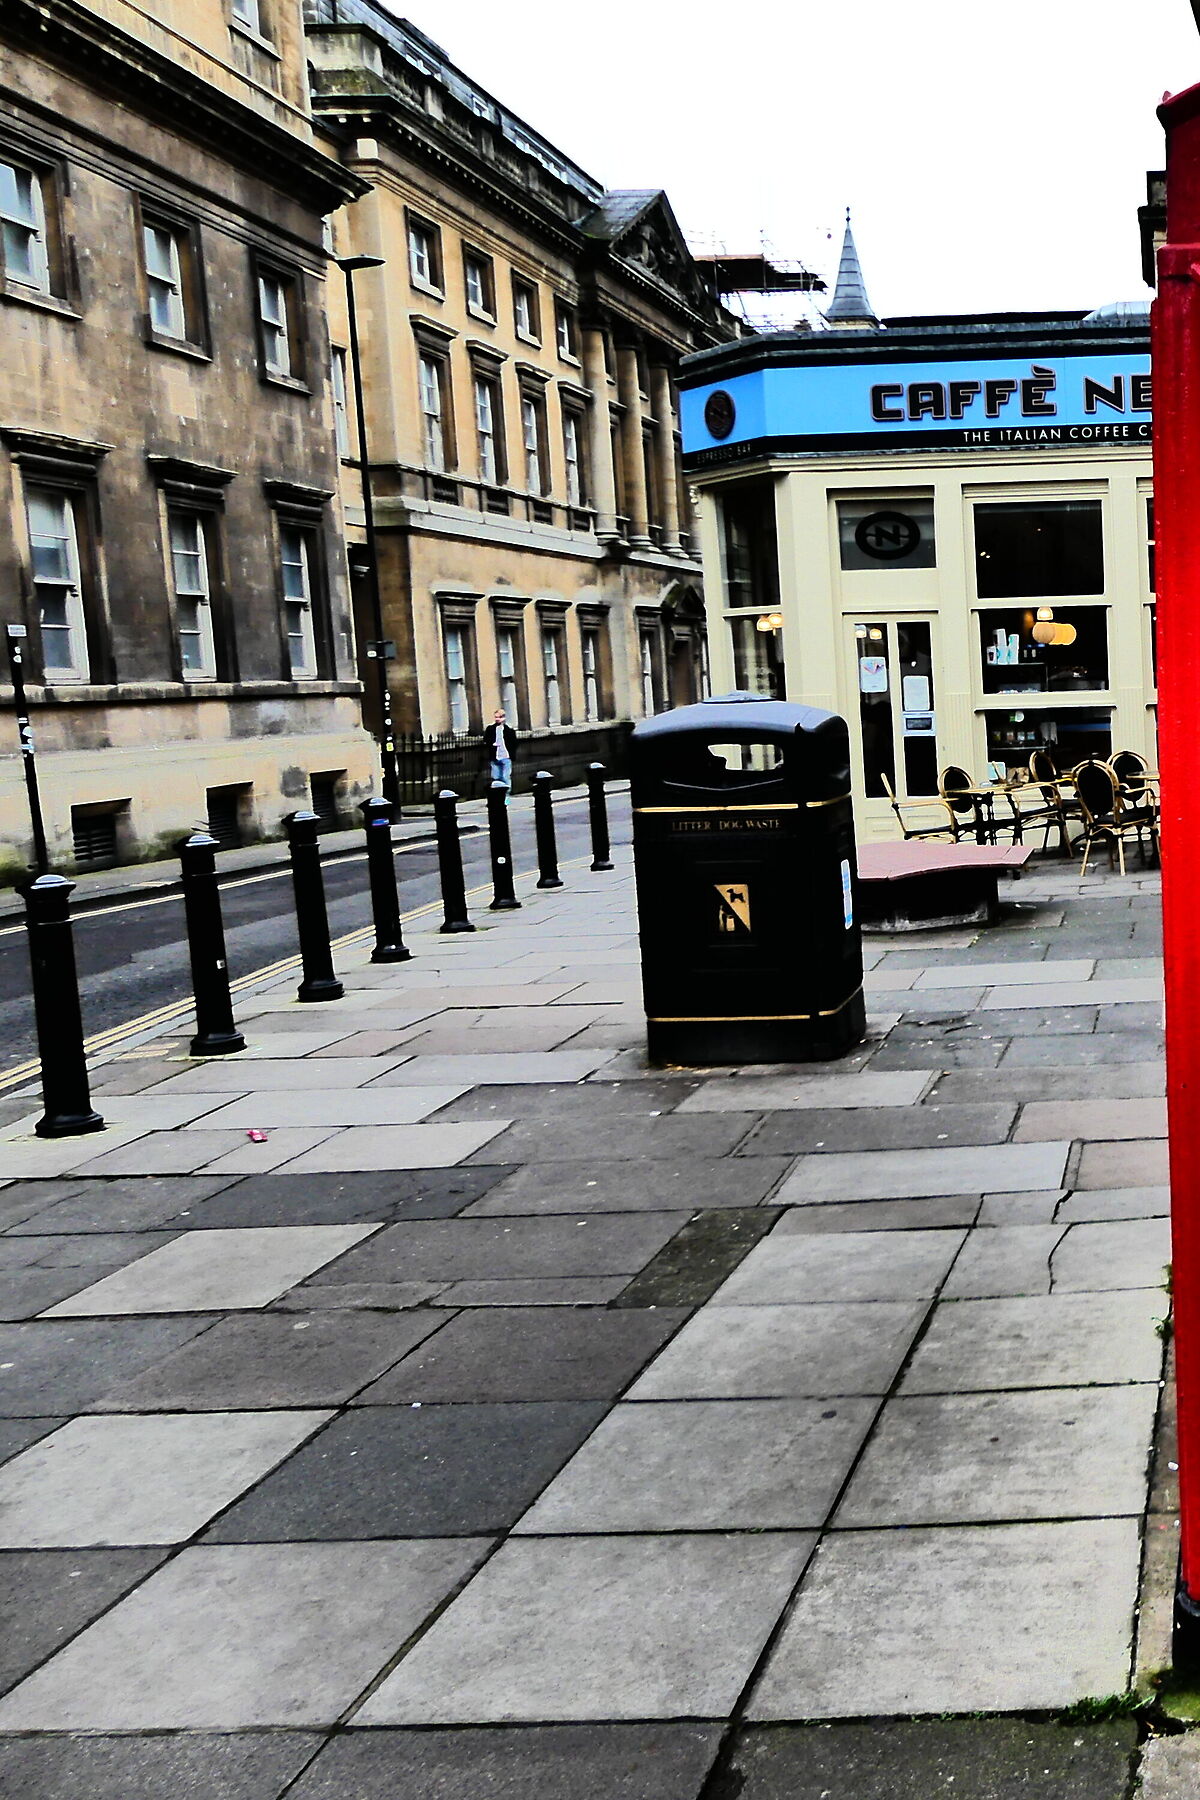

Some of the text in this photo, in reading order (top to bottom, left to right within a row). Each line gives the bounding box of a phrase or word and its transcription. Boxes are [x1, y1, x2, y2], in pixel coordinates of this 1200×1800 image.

[870, 364, 1056, 422] CAFFÈ
[963, 424, 1152, 443] THE ITALIAN COFFEE C
[672, 818, 781, 831] LITTER DOG WASTE
